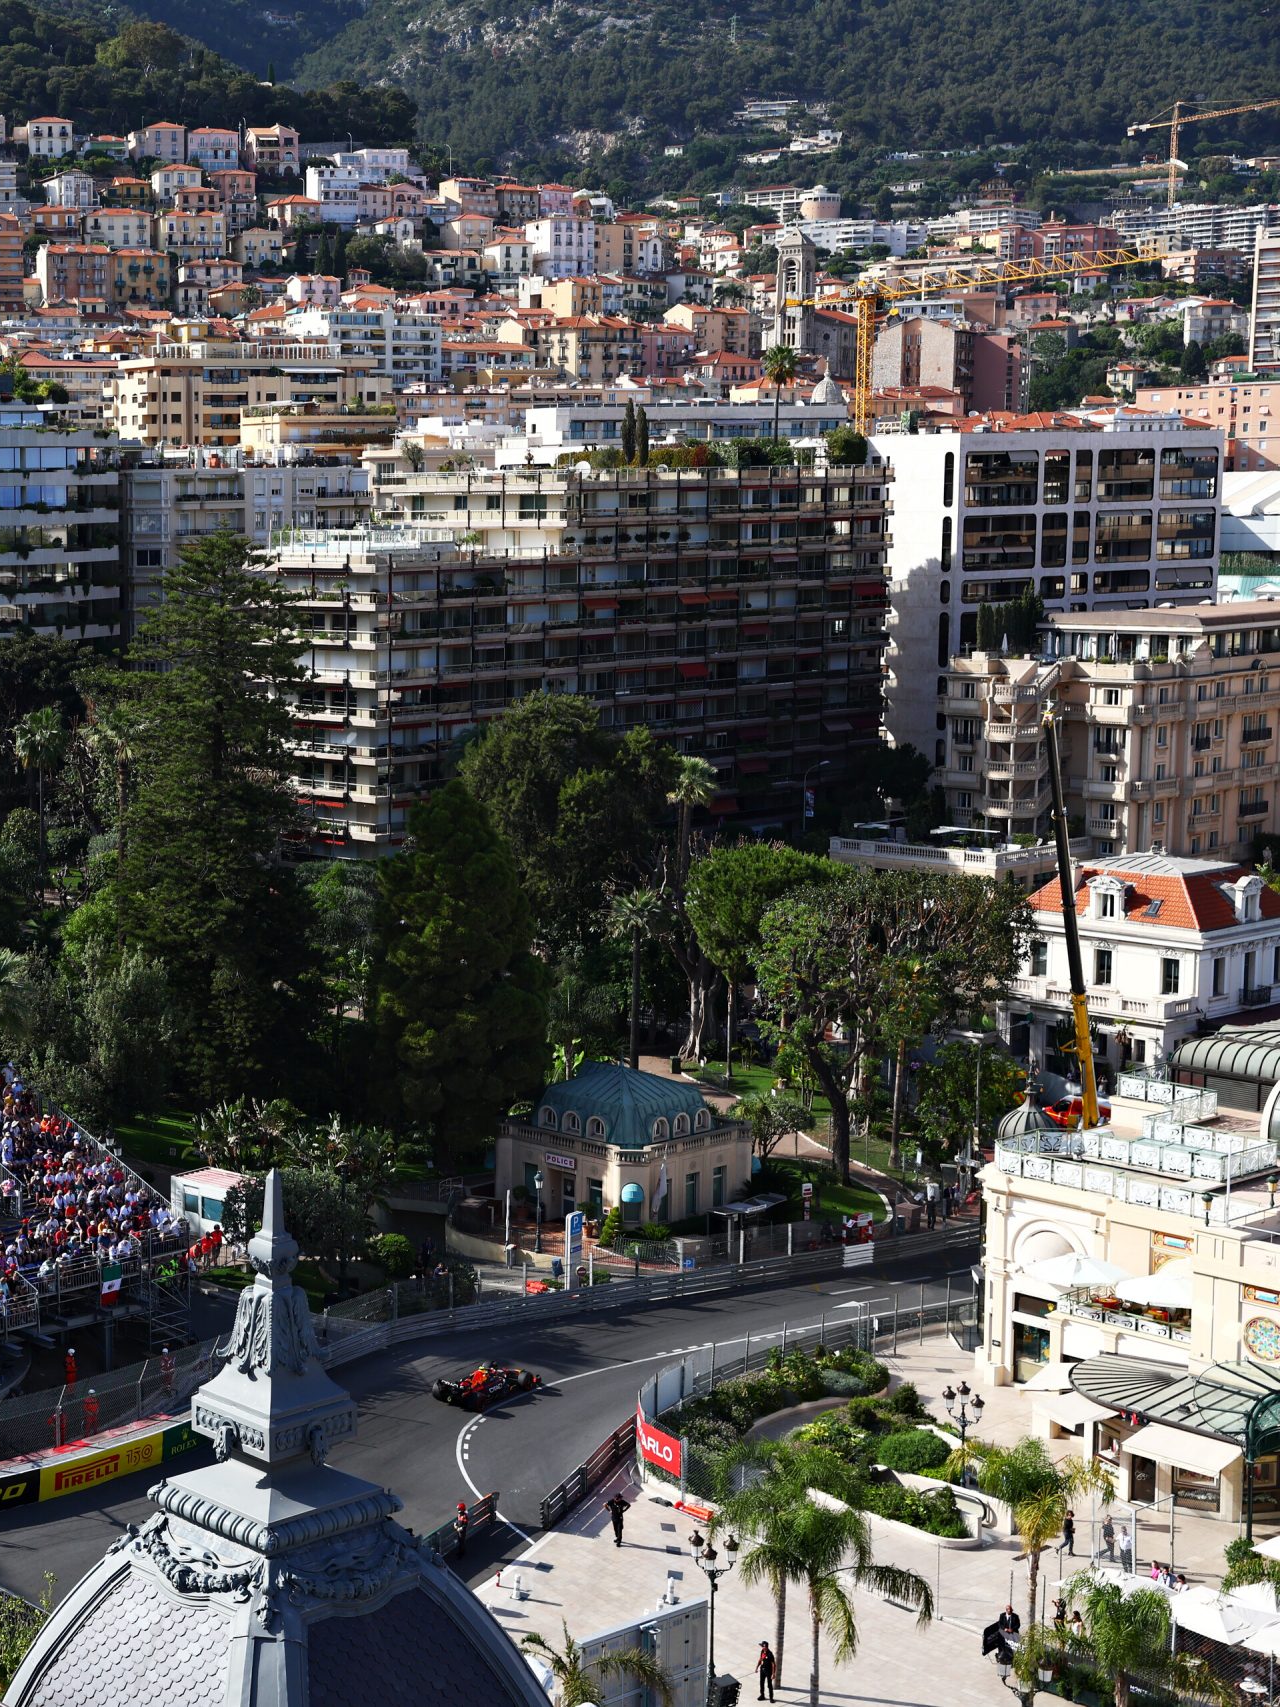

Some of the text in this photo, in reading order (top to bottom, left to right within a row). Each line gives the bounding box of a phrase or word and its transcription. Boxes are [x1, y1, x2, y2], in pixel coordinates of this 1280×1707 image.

[546, 1155, 573, 1167] POLICE
[573, 1216, 579, 1228] P
[171, 1438, 197, 1455] ROLEX
[54, 1453, 121, 1491] PIRELLI
